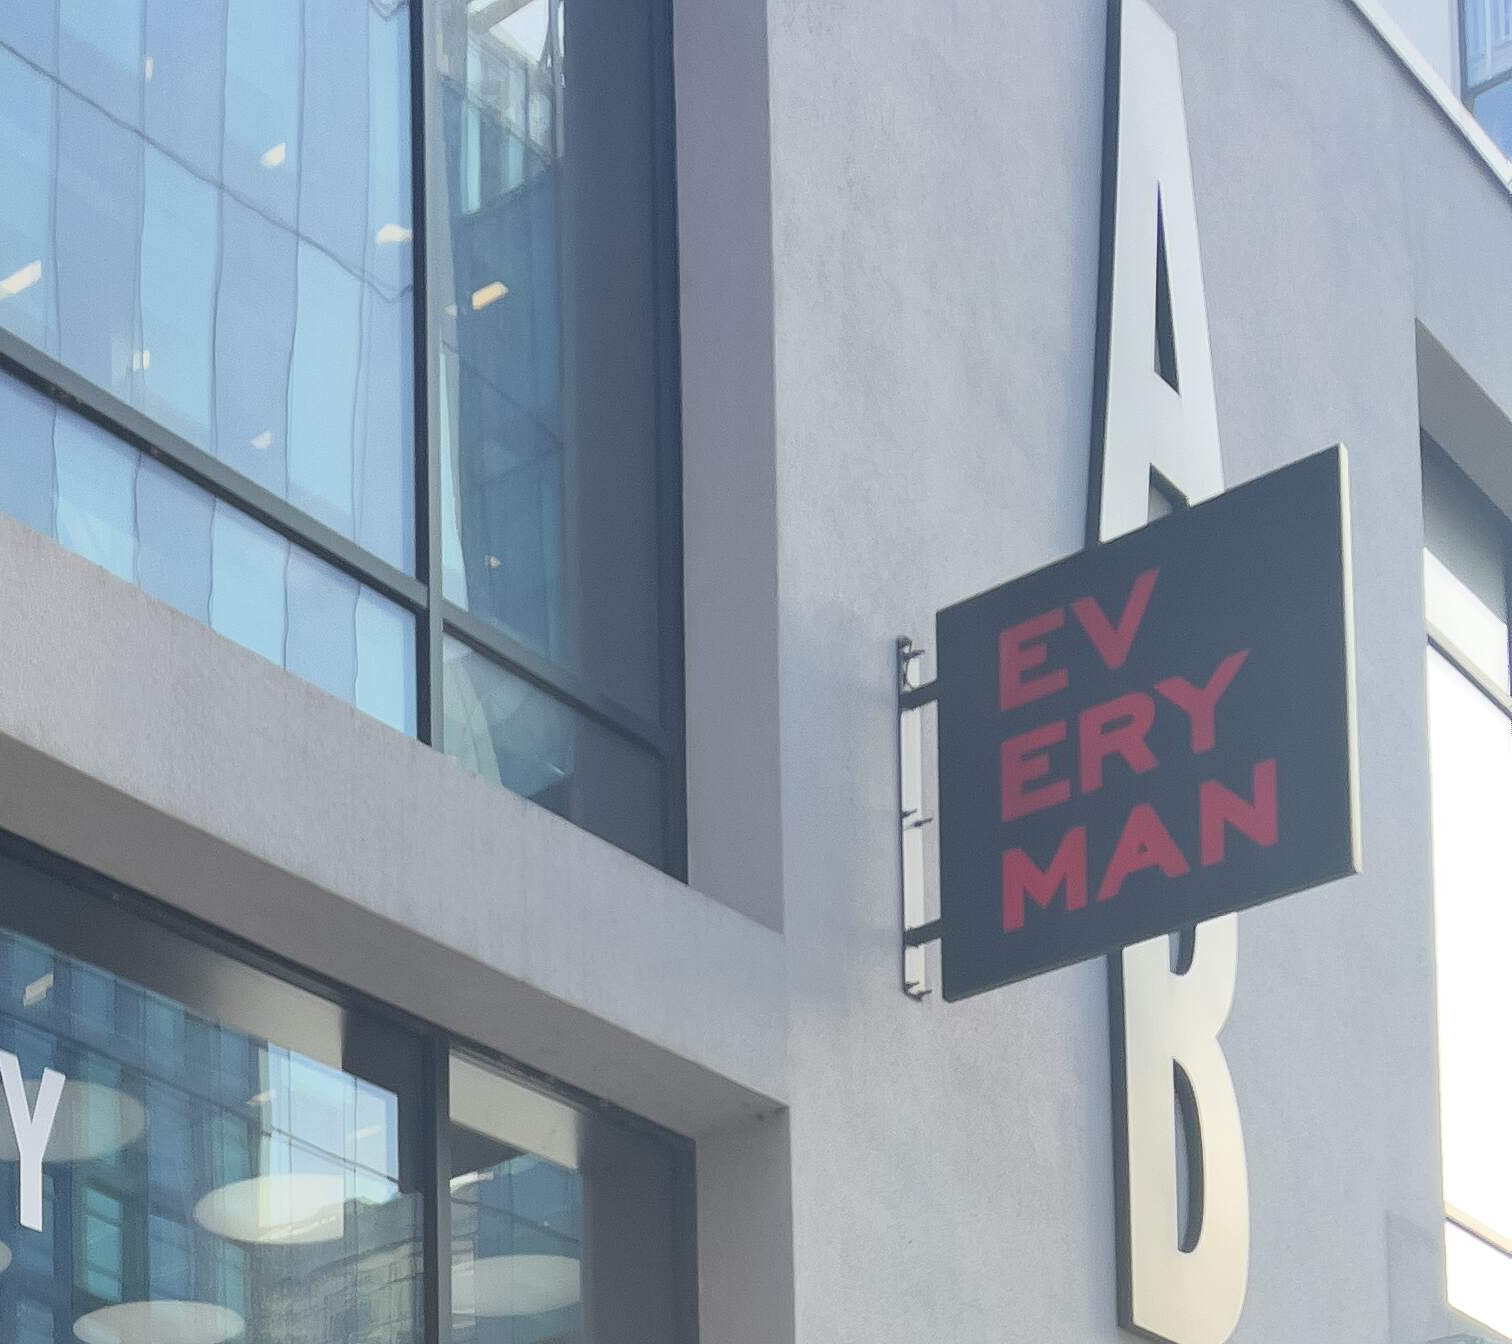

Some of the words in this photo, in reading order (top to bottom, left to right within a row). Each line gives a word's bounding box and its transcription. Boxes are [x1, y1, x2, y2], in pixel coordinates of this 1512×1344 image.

[998, 567, 1161, 714] EV
[998, 648, 1253, 823] ERY
[1000, 757, 1279, 934] MAN
